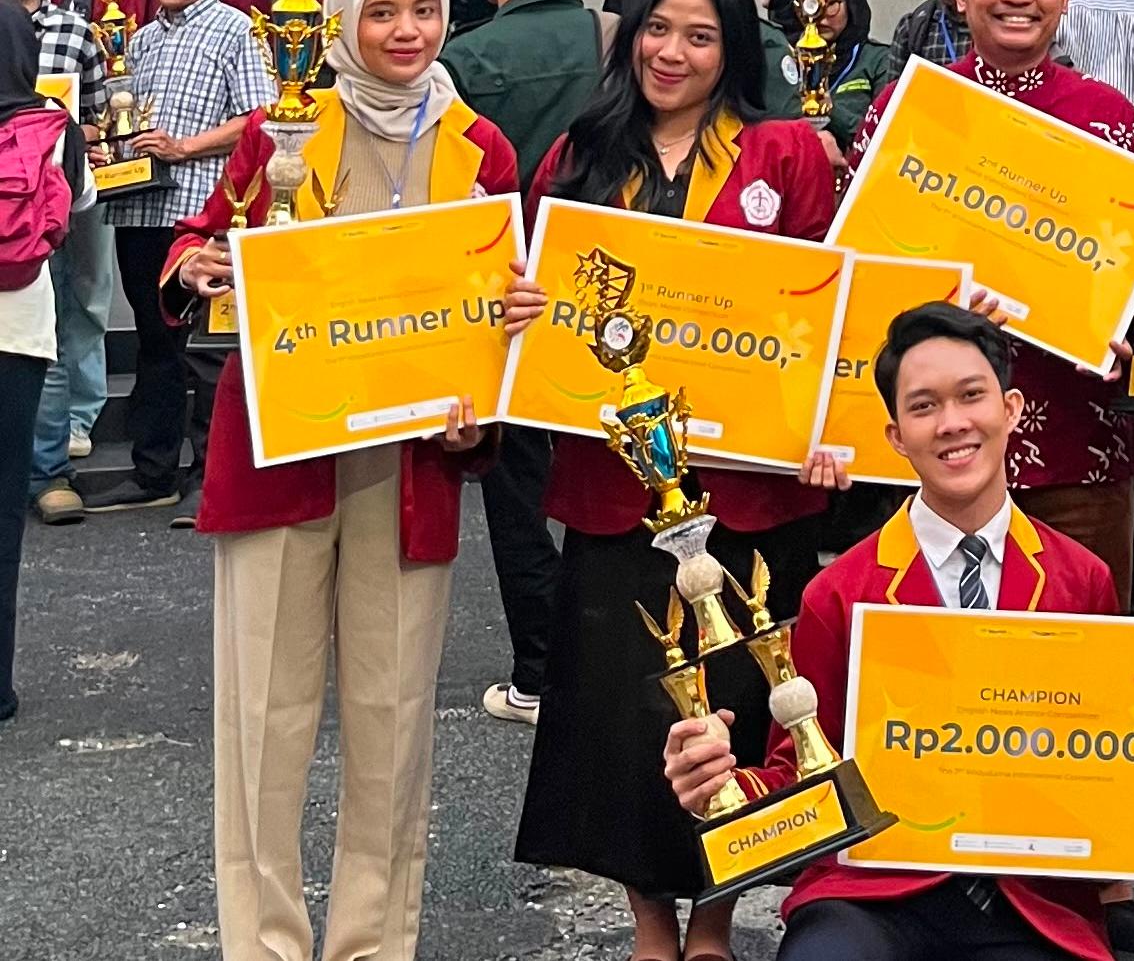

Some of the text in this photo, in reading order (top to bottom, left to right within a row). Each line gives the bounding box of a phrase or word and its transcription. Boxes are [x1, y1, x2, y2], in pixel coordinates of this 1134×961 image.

[999, 165, 1047, 194] Runner
[1049, 187, 1068, 204] Up
[897, 154, 1117, 271] Rp1.000.000,-
[656, 285, 710, 304] Runner
[714, 295, 734, 310] Up
[274, 323, 318, 355] 4th
[328, 307, 452, 347] Runner
[462, 296, 506, 328] Up
[979, 687, 1082, 706] CHAMPION
[727, 806, 819, 856] CHAMPION
